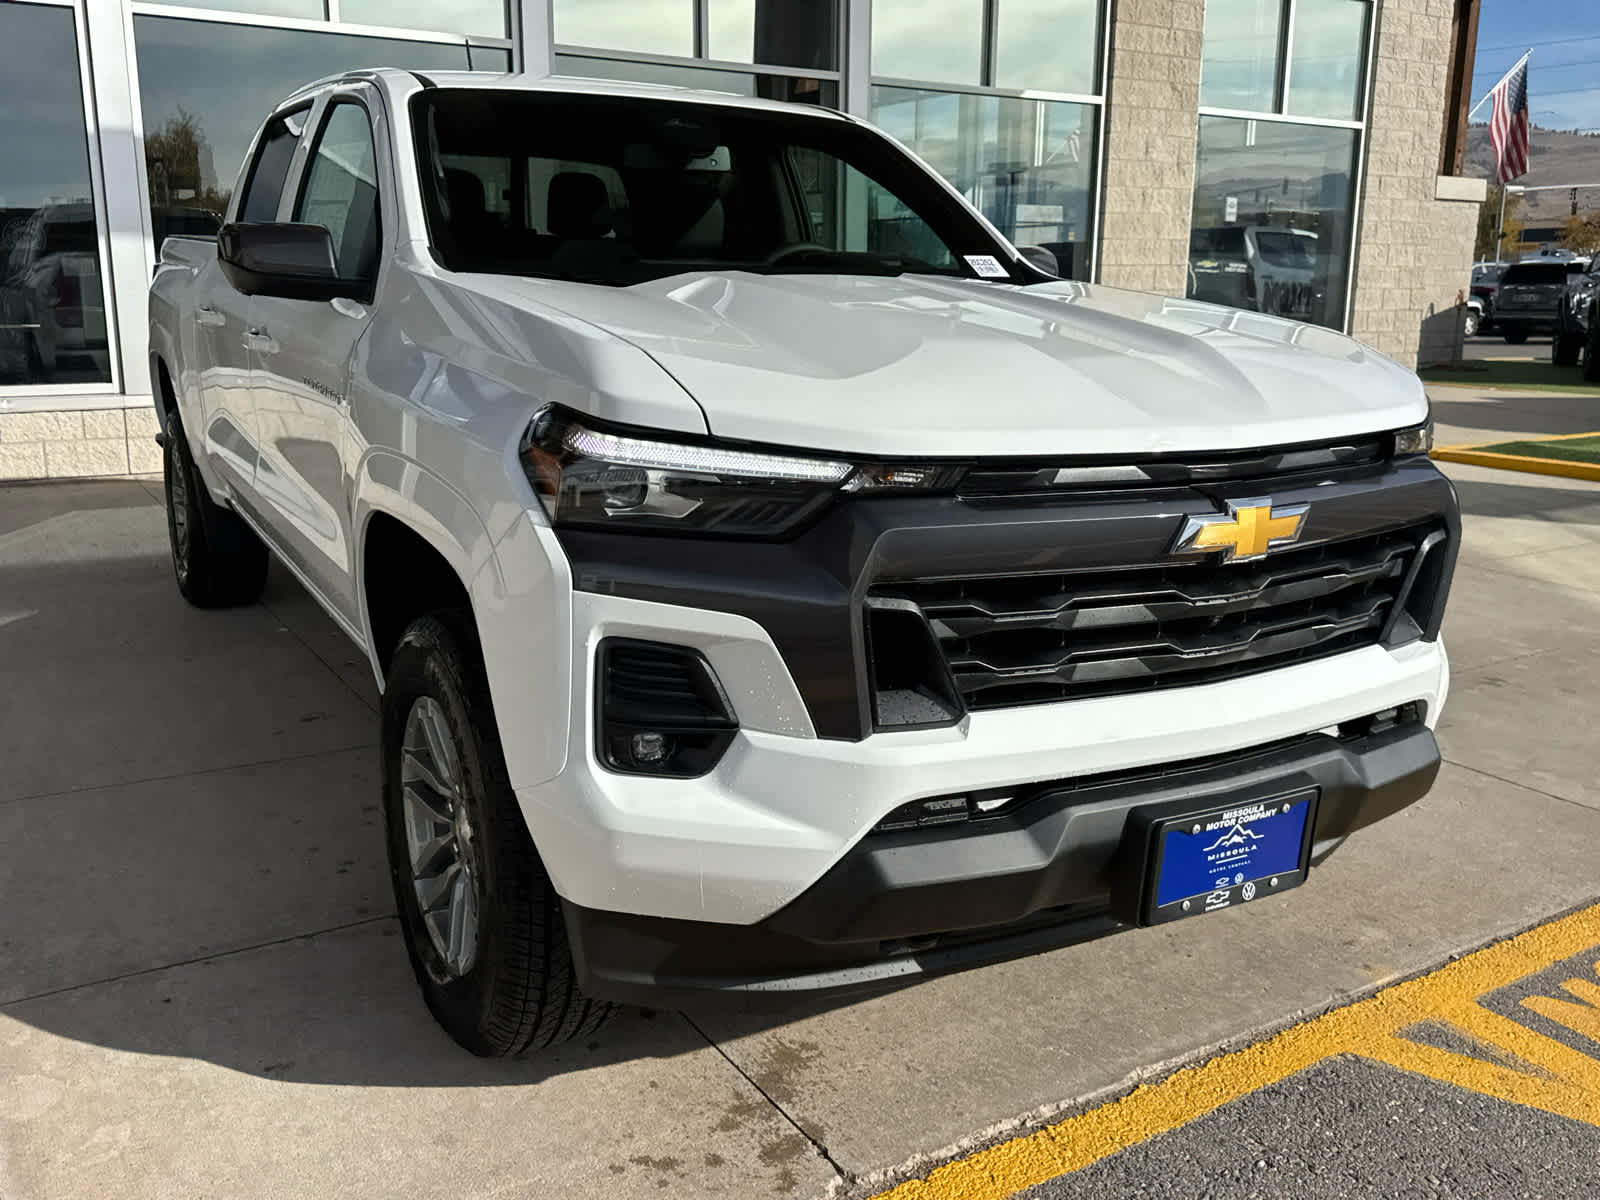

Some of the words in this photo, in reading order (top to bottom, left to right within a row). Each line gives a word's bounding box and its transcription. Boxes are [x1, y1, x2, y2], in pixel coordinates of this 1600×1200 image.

[1206, 819, 1237, 831] MOTOR
[1237, 807, 1278, 824] COMPANY
[1222, 804, 1265, 820] MISSOULA
[1207, 844, 1257, 861] MISSOULA
